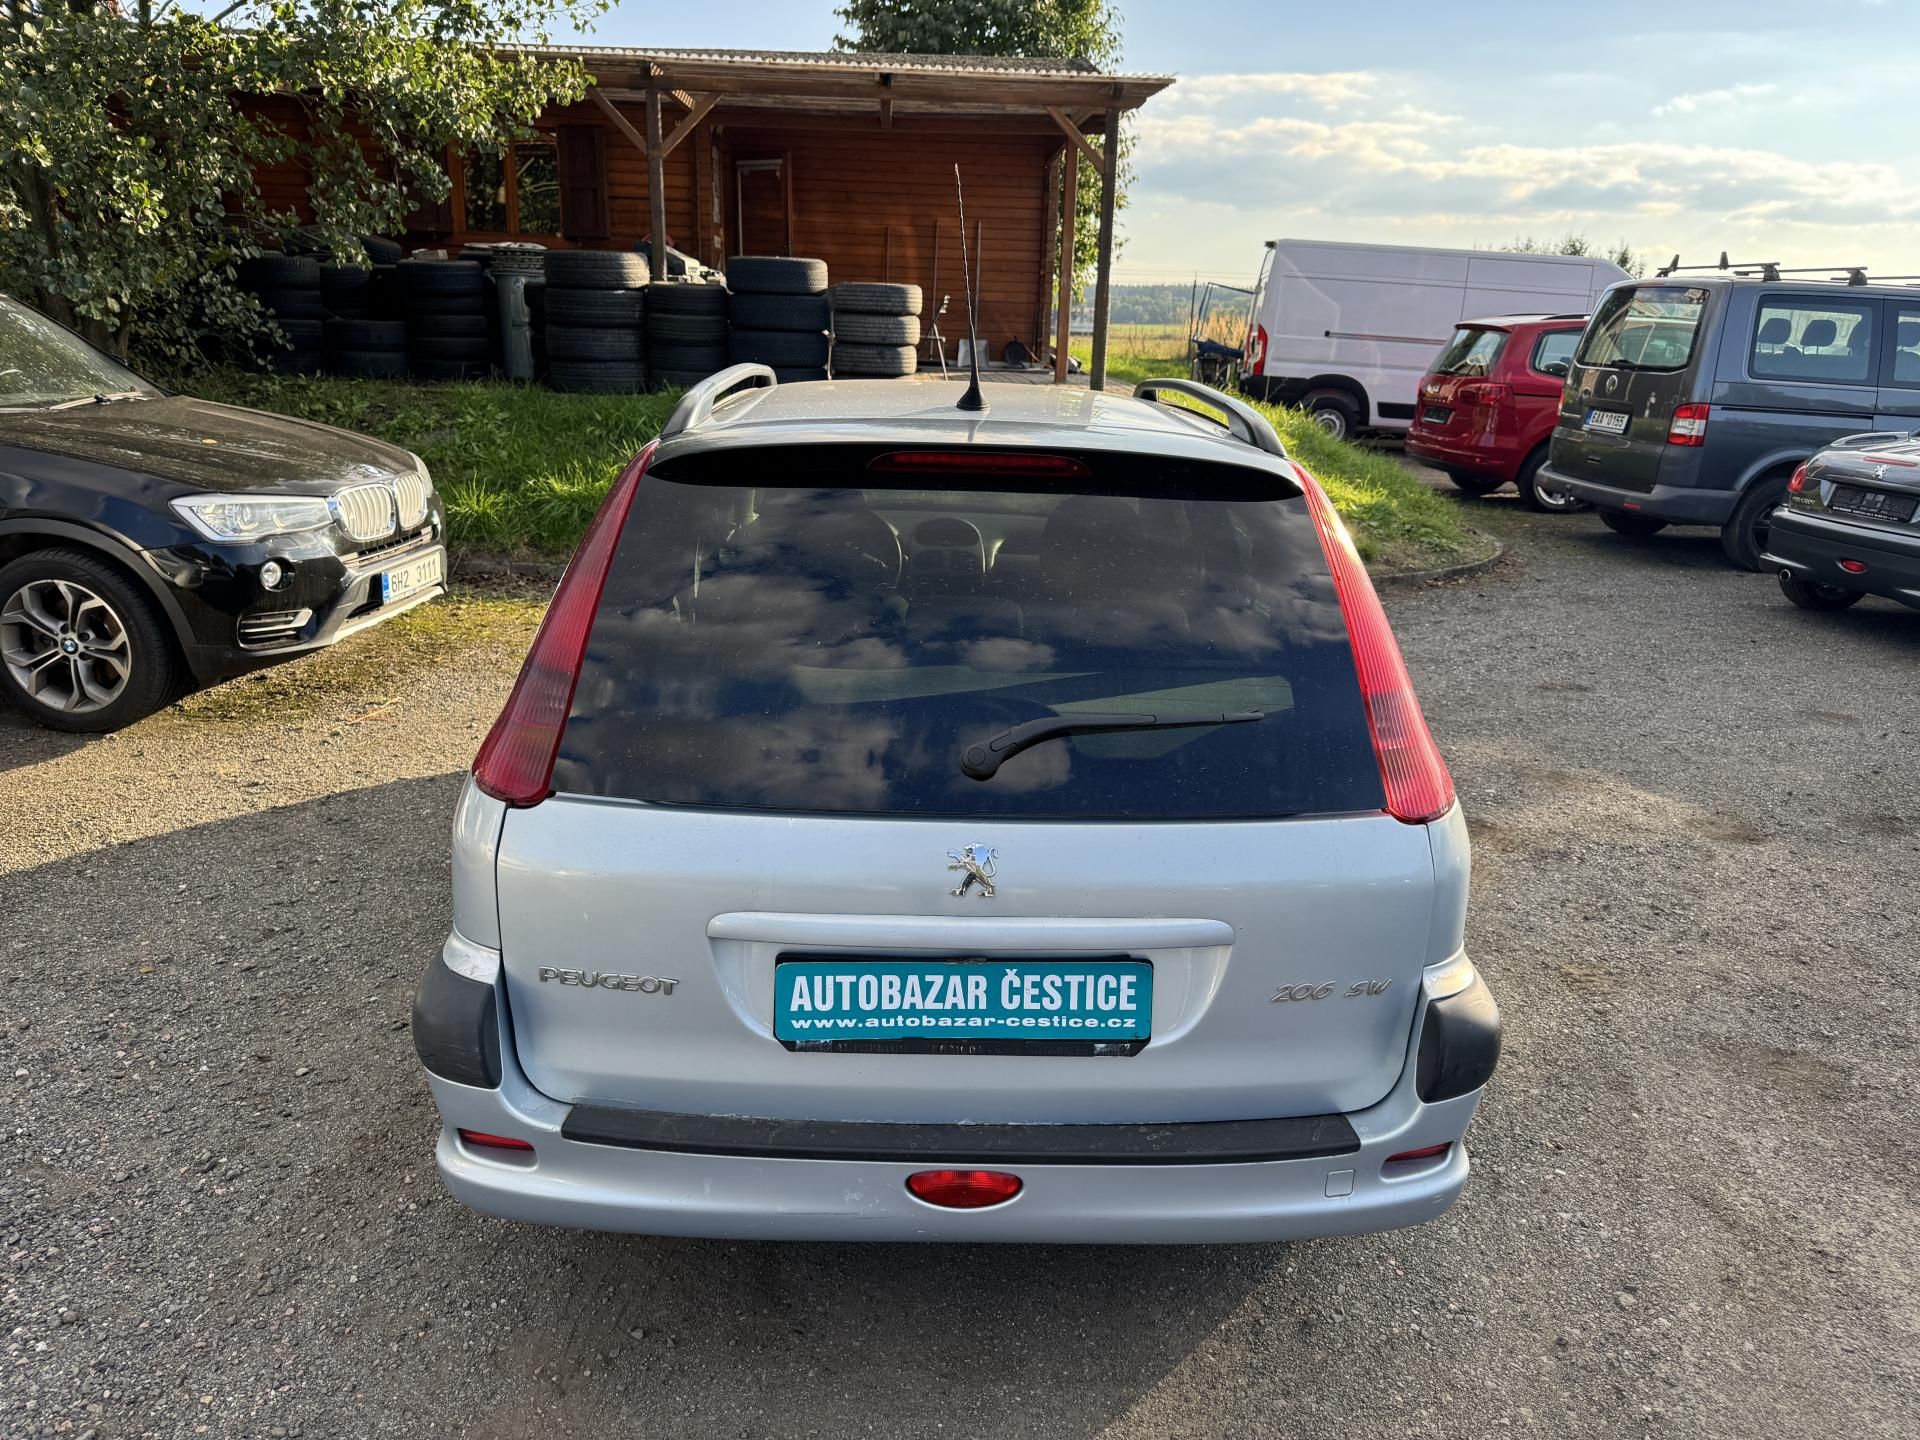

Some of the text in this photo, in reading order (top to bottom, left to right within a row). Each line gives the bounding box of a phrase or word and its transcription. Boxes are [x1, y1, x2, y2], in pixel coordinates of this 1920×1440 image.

[391, 558, 436, 592] 6H2 3111
[538, 965, 680, 996] PEUGEOT
[789, 968, 1137, 1012] AUTOBAZAR ČESTICE
[1269, 978, 1393, 1003] 206 SW
[790, 1014, 1137, 1029] www.autobazar-cestice.cz
